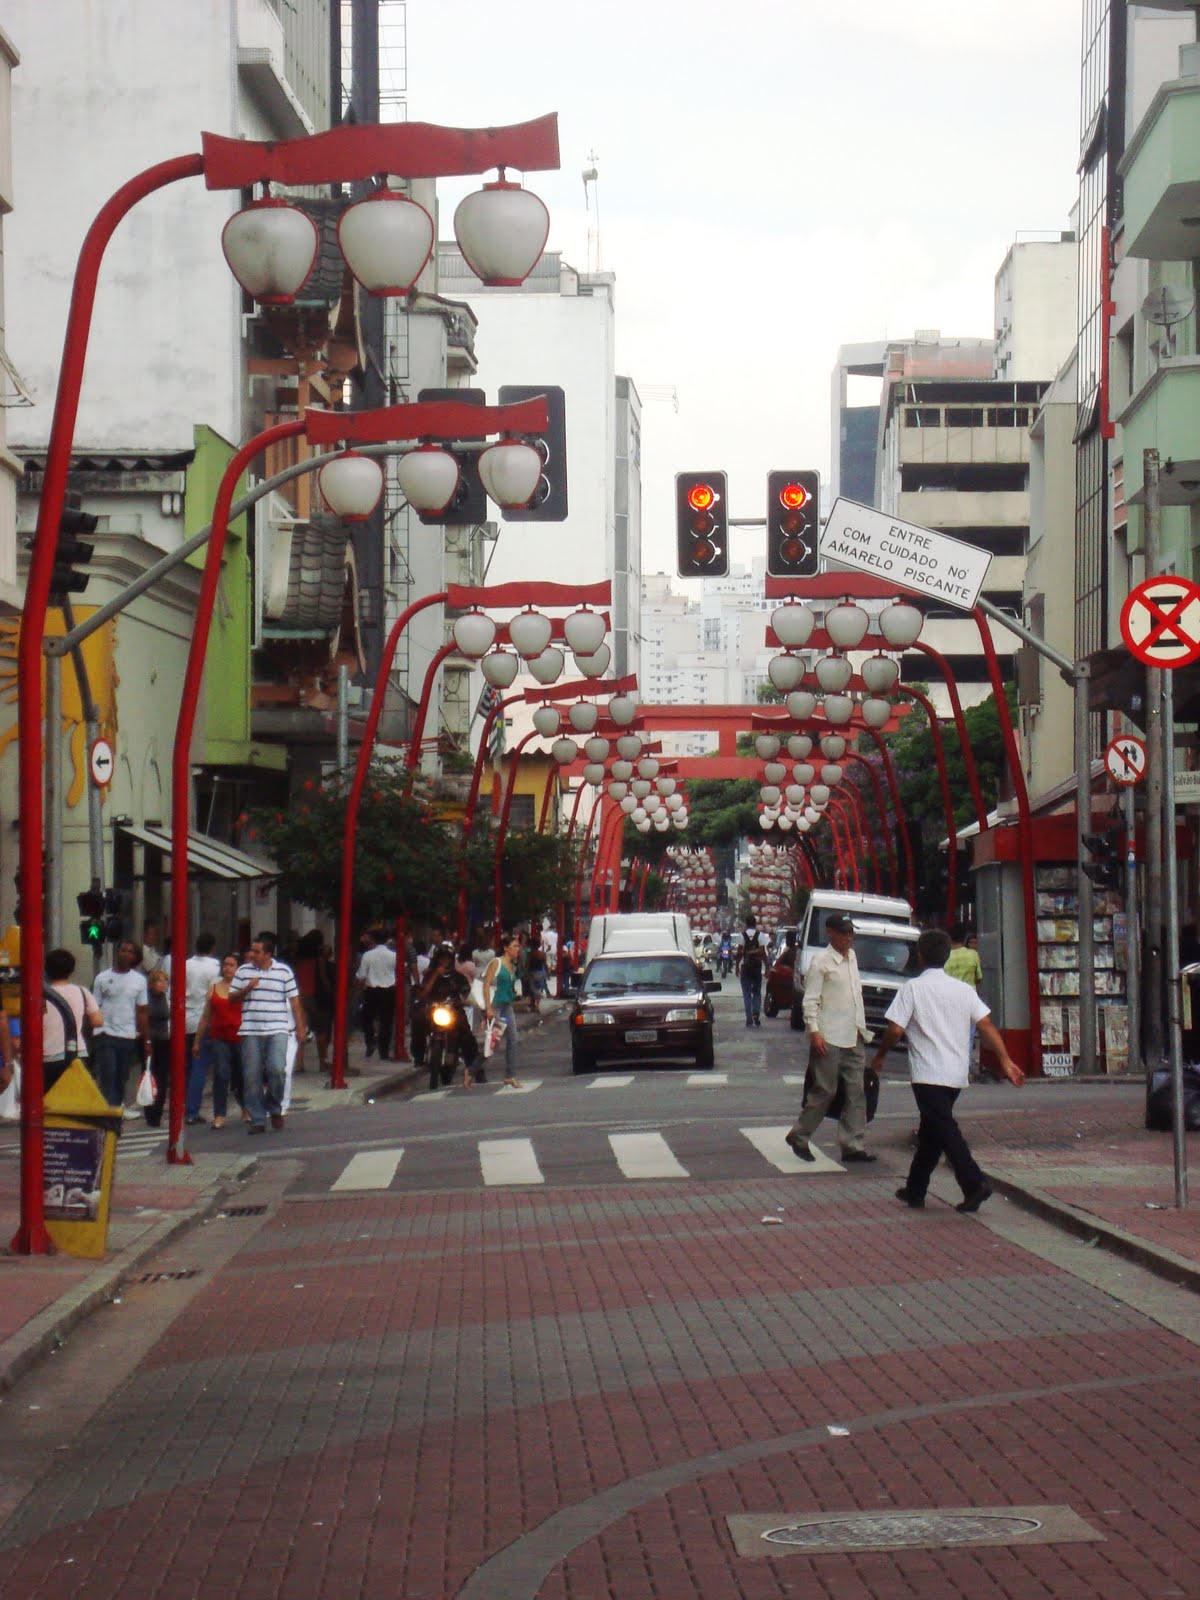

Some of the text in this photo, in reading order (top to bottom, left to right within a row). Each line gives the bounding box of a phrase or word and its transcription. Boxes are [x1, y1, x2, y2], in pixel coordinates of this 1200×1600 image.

[842, 526, 967, 580] COM CUIDADO NO
[888, 525, 933, 550] ENTRE
[827, 540, 971, 600] AMARELO PISCANTE
